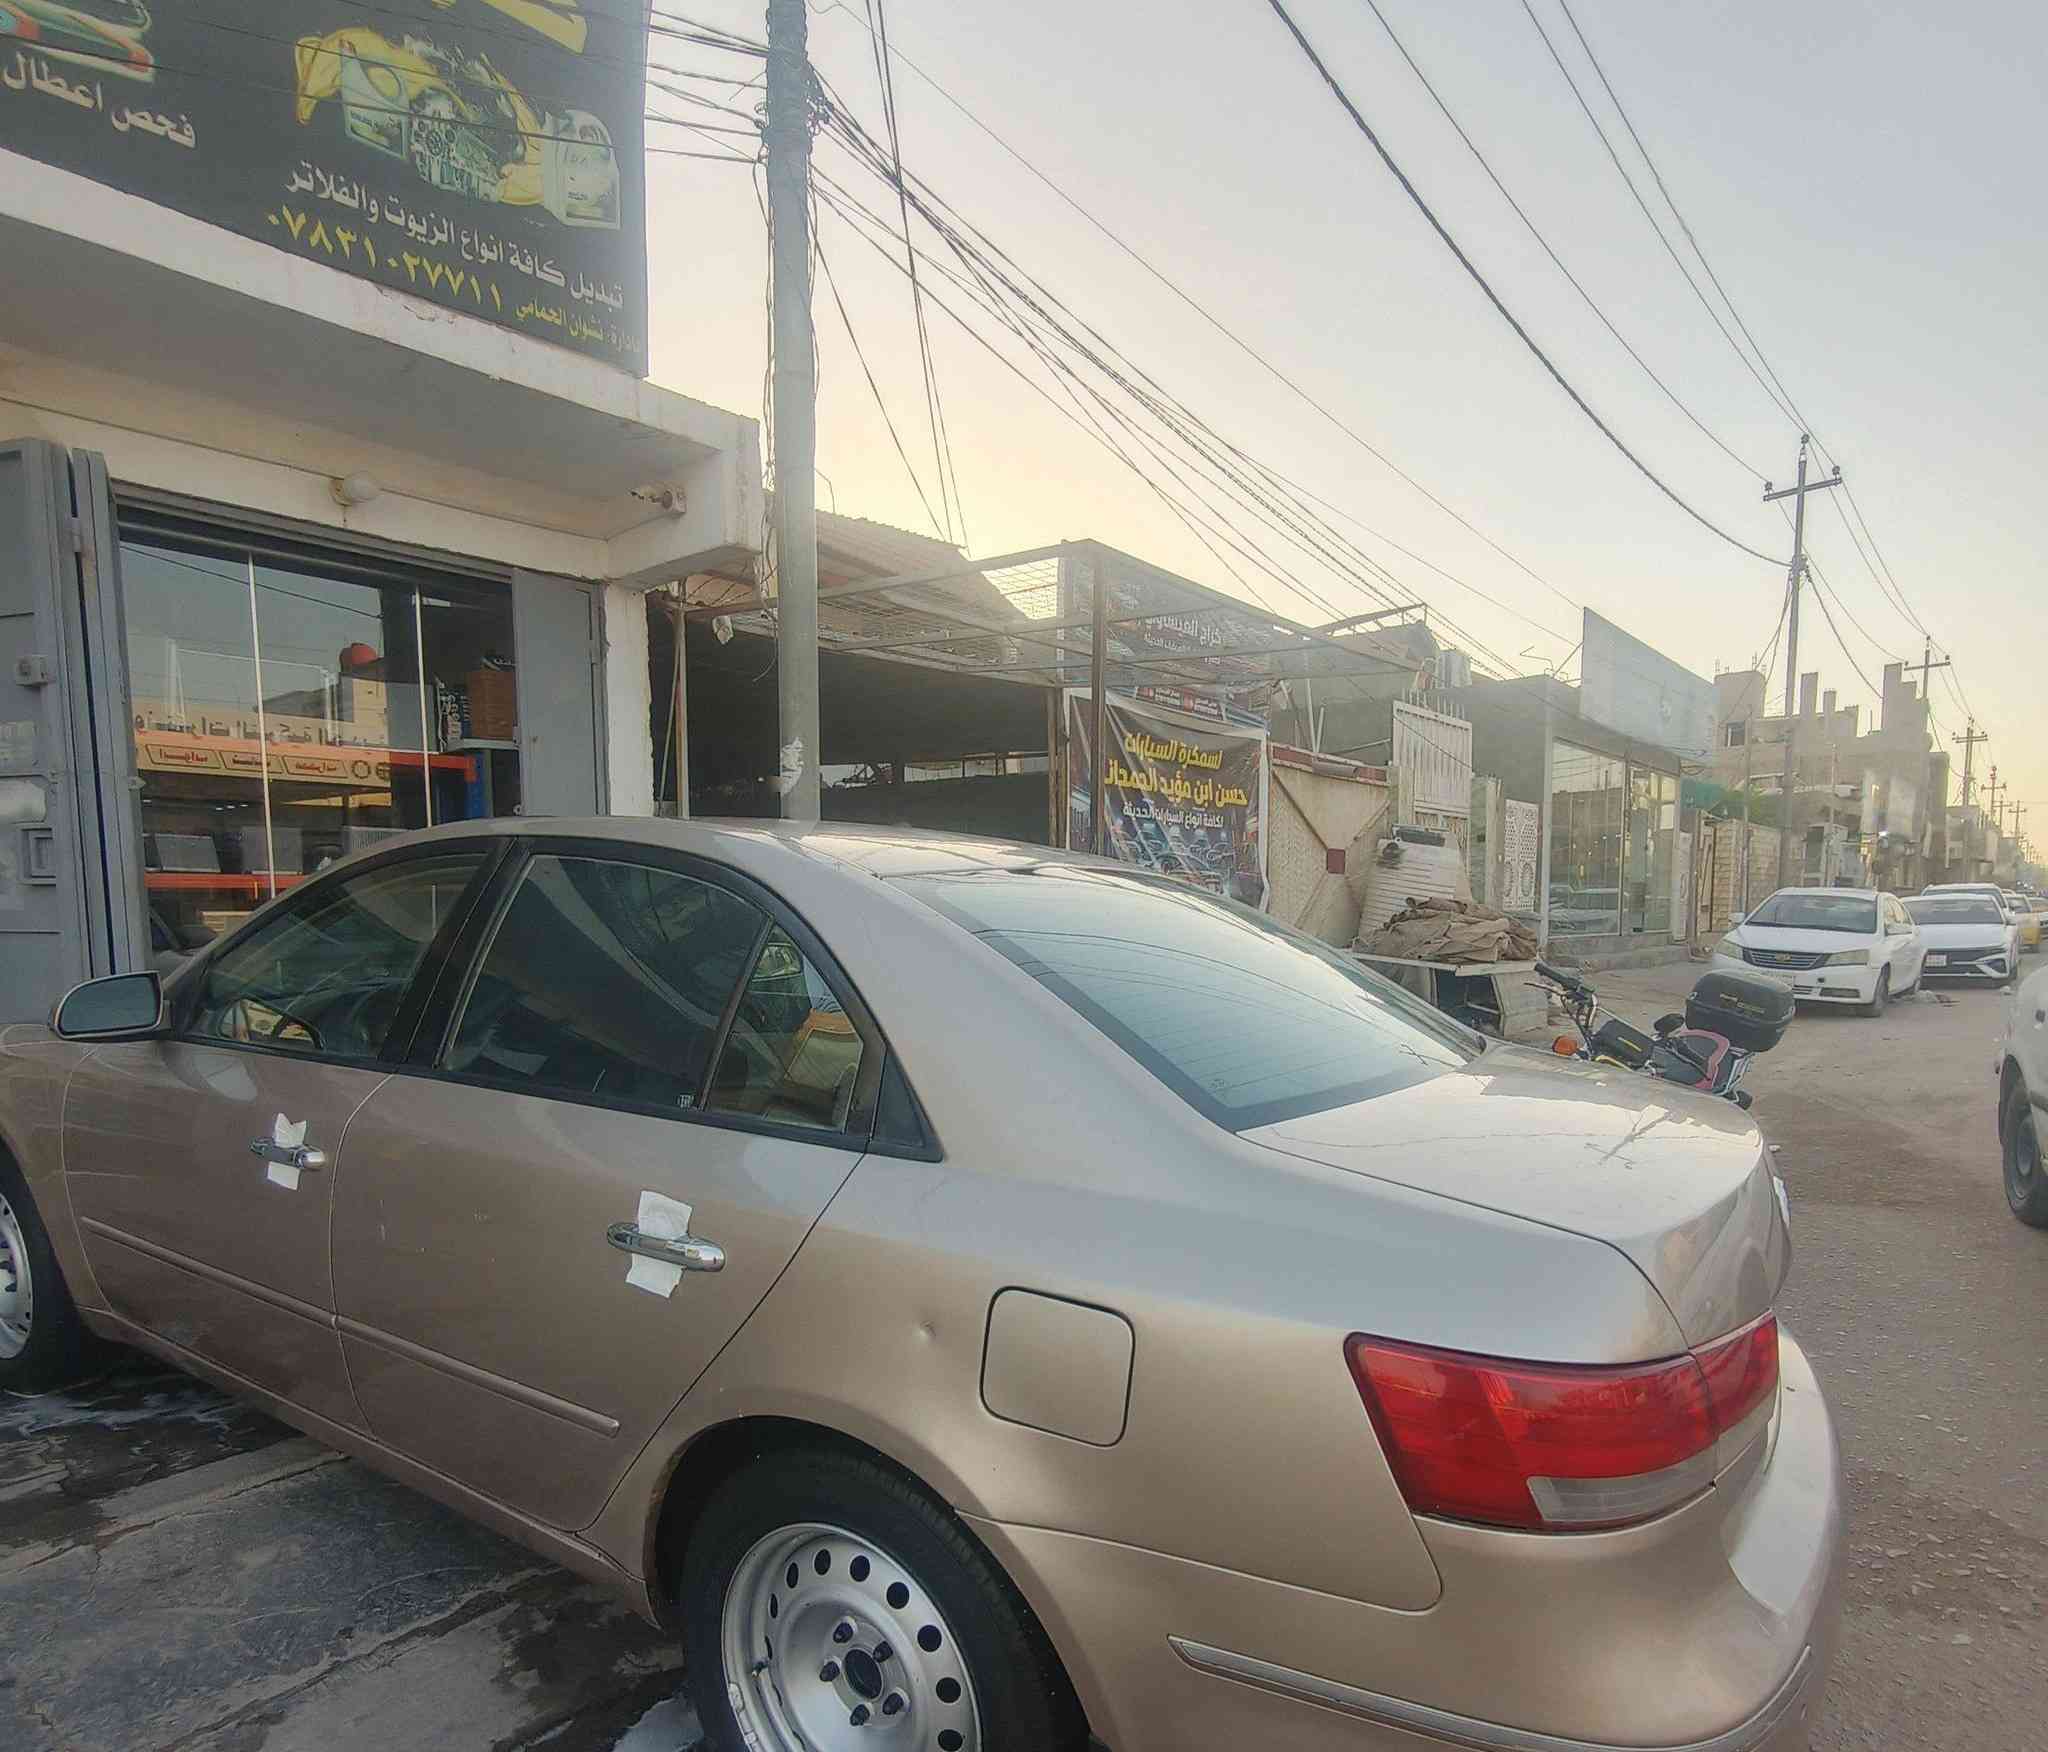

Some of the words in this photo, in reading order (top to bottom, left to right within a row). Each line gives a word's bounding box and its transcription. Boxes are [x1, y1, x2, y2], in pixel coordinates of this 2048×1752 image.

[3, 51, 104, 112] اعطال
[112, 107, 196, 148] فحص
[284, 160, 380, 223] والفلاتر
[384, 195, 455, 246] الزيوت
[460, 227, 504, 265] انواع
[508, 240, 566, 287] كافة
[569, 272, 624, 312] تبديل
[1124, 732, 1178, 761] السيارات
[1178, 741, 1224, 770] لسمكرة
[1194, 778, 1213, 808] ابن
[1215, 783, 1249, 808] حسن
